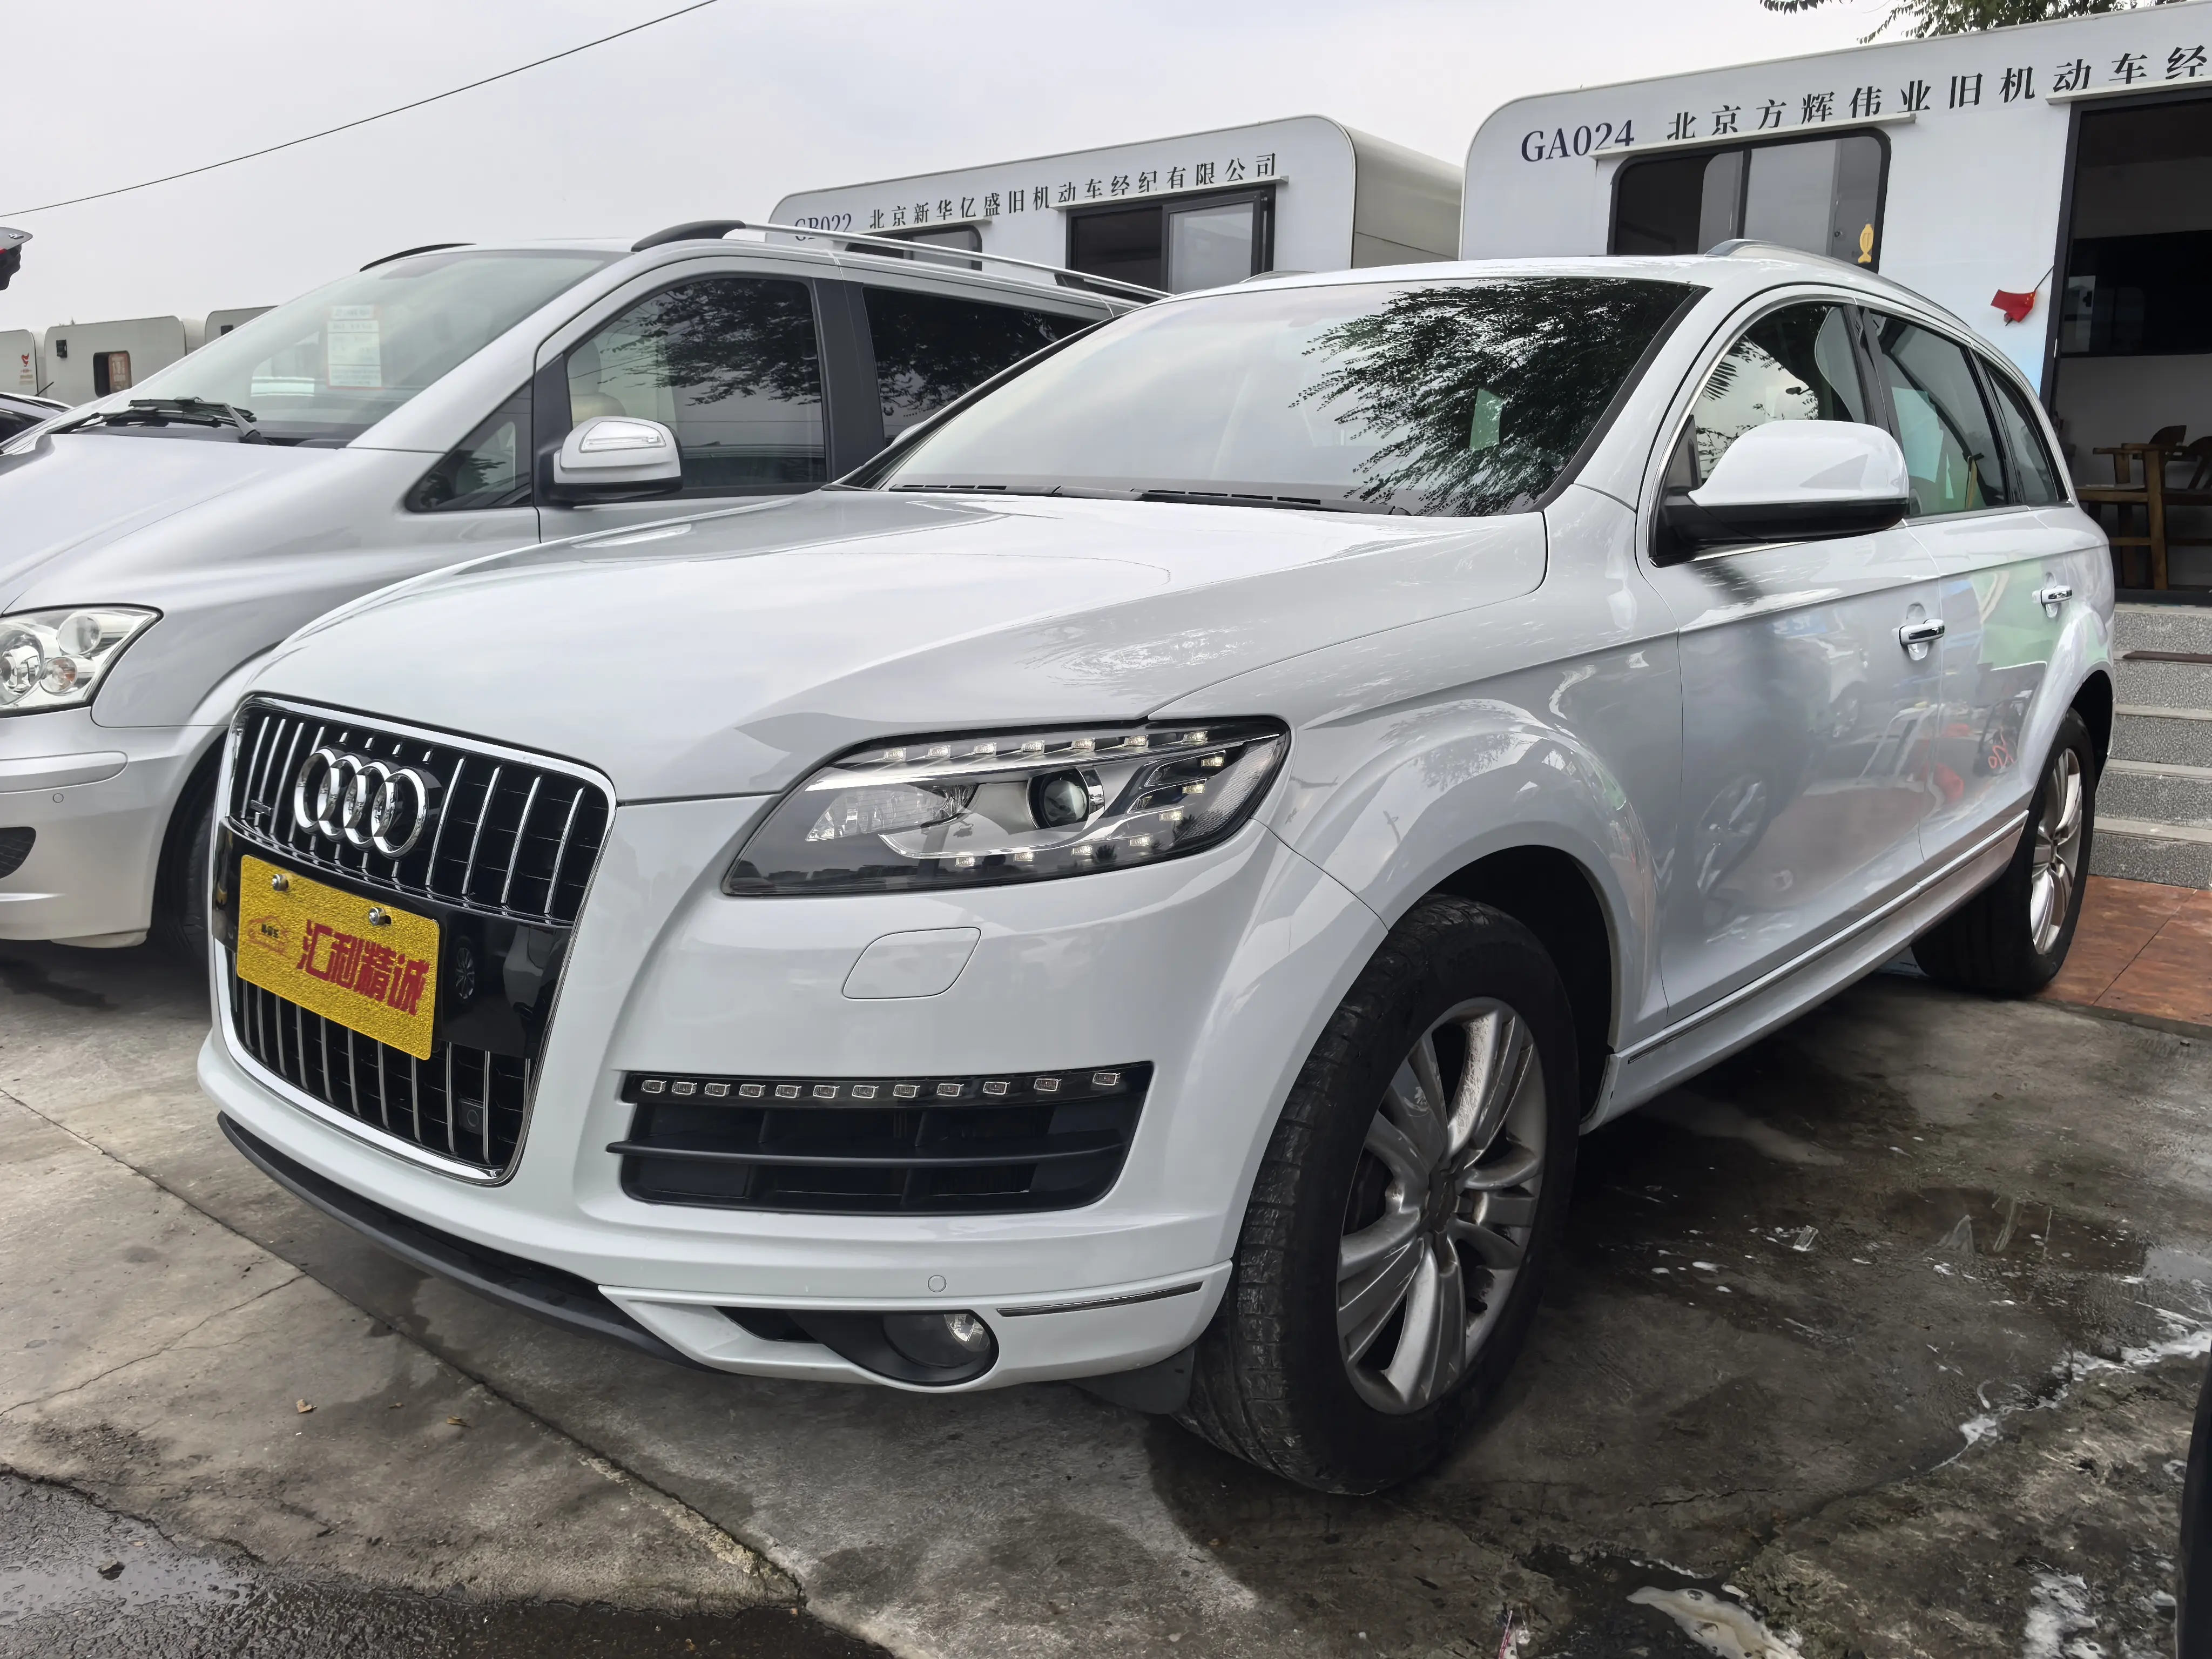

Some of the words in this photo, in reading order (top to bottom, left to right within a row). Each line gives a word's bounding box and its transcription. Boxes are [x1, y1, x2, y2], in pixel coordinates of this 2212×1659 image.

[1667, 45, 2208, 140] 北京方辉伟业旧机动车经
[1521, 119, 1634, 162] GA024
[869, 152, 1276, 230] 北京新华亿盛旧机动车经纪有限公司
[296, 919, 430, 1016] 汇利精诚
